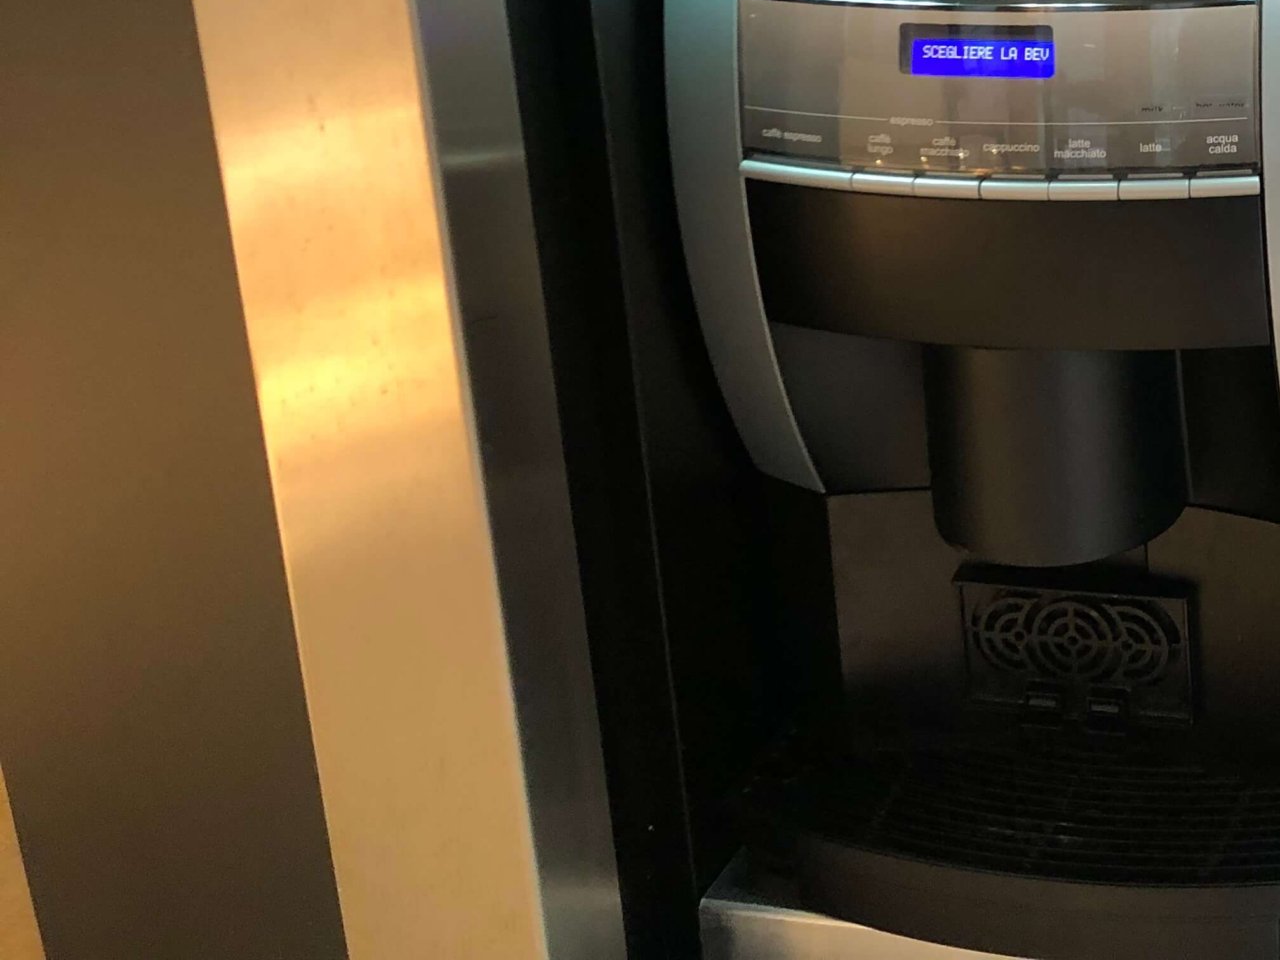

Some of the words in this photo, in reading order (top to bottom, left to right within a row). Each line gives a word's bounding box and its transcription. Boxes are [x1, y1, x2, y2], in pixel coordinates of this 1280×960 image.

[922, 45, 994, 60] SCEGLIERE
[1000, 47, 1018, 60] LA
[1024, 47, 1050, 61] BEV
[889, 116, 934, 127] espresso
[1068, 138, 1091, 149] latte
[1206, 134, 1239, 145] acqua
[867, 144, 894, 156] lungo
[920, 148, 970, 158] macchiato
[983, 143, 1040, 154] cappuccino
[1139, 142, 1162, 153] latte
[1208, 144, 1238, 155] calda
[1053, 149, 1107, 159] macchiato
